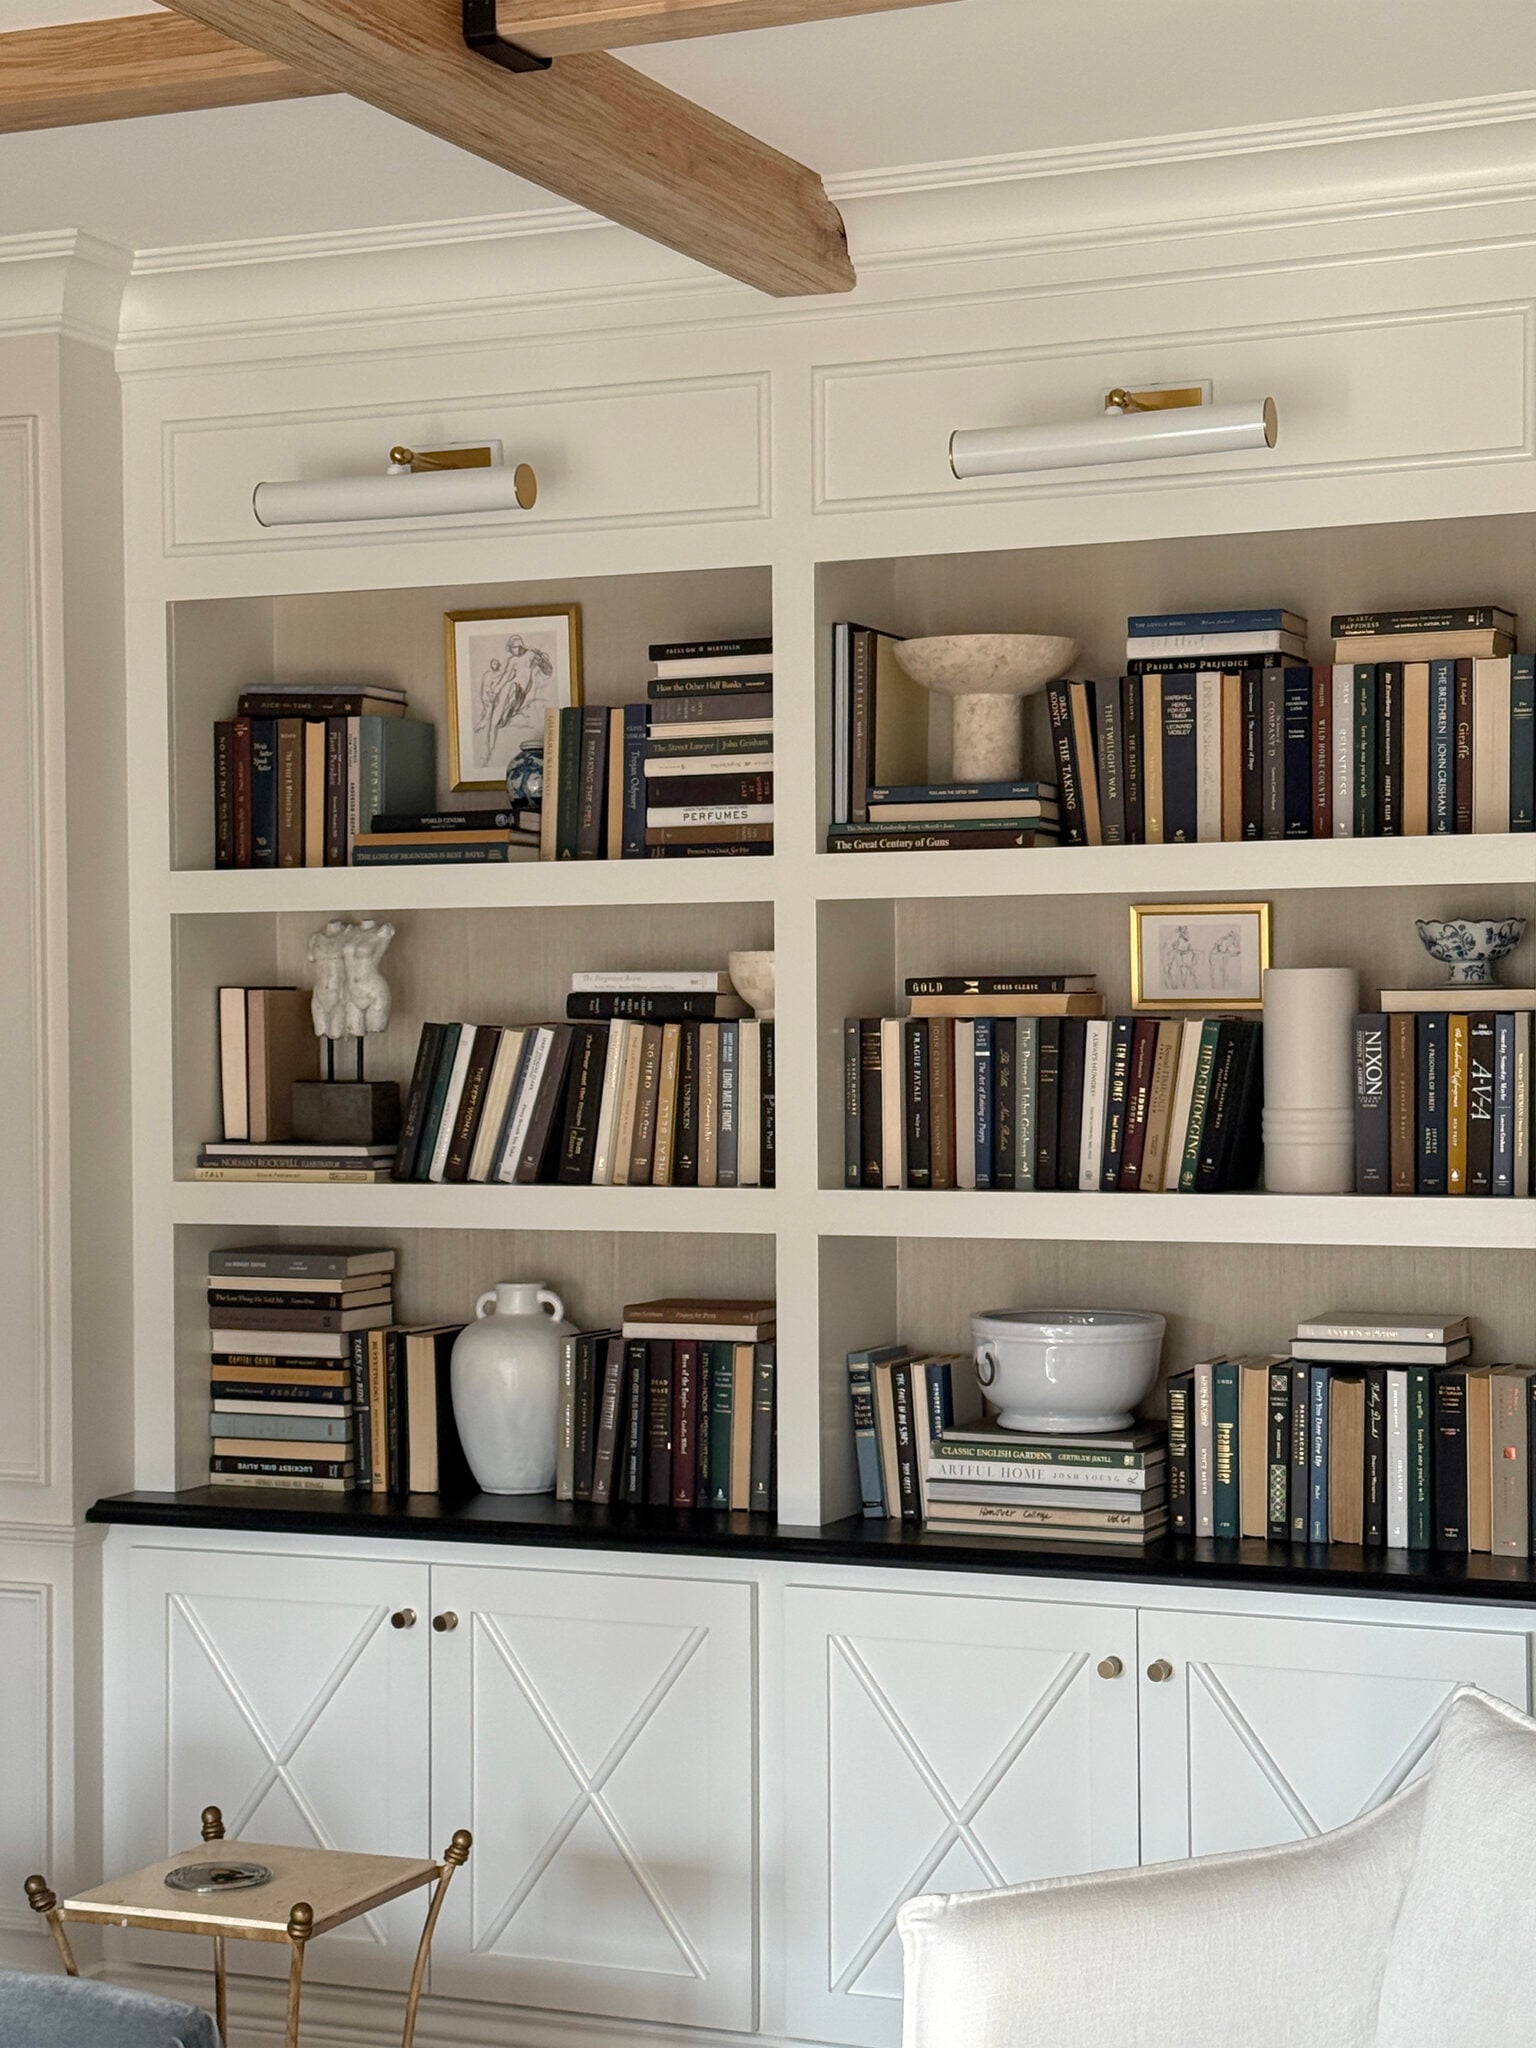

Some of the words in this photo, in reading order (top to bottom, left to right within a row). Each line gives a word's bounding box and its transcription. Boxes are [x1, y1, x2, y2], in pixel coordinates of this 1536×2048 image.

[1340, 622, 1379, 630] HAPPINESS
[1146, 662, 1173, 671] PRIDE
[1200, 660, 1248, 669] PREJUDICE
[1438, 666, 1447, 685] THE
[656, 684, 672, 692] How
[674, 683, 683, 691] the
[685, 682, 704, 690] Other
[706, 681, 720, 690] Half
[722, 680, 741, 688] Banks
[1050, 692, 1060, 727] KOONTZ
[1058, 696, 1068, 719] DEAN
[1104, 704, 1113, 723] THE
[1438, 686, 1447, 733] BRETHREN
[1318, 719, 1326, 740] WILD
[653, 744, 666, 752] The
[668, 742, 688, 751] Street
[690, 742, 713, 751] Lawyer
[722, 740, 737, 750] John
[739, 738, 768, 748] Grisham
[1059, 737, 1070, 762] THE
[1106, 726, 1116, 773] TWILIGHT
[1128, 734, 1136, 752] THE
[1458, 722, 1469, 759] Giraffe
[586, 740, 596, 782] BREAKING
[630, 750, 640, 776] Trojan
[1338, 729, 1346, 795] RELENTLESS
[1437, 743, 1446, 769] JOHN
[585, 786, 593, 802] THE
[628, 778, 640, 810] Odyssey
[1062, 764, 1076, 811] TAKING
[1109, 778, 1117, 799] WAR
[1437, 770, 1446, 816] GRISHAM
[584, 804, 592, 828] SPELL
[683, 811, 748, 821] PERFUMES
[835, 840, 852, 849] The
[853, 839, 878, 849] Great
[879, 839, 913, 850] Century
[914, 838, 925, 847] of
[926, 838, 949, 846] Guns
[913, 982, 943, 992] GOLD
[585, 1034, 593, 1049] The
[1022, 1028, 1031, 1047] The
[647, 1043, 654, 1058] NO
[913, 1032, 921, 1068] PRAGUE
[1116, 1043, 1127, 1058] TEN
[583, 1050, 591, 1070] Bear
[1021, 1050, 1030, 1085] Partner
[1364, 1030, 1383, 1096] NIXON
[475, 1067, 484, 1082] THE
[580, 1071, 588, 1086] and
[644, 1062, 654, 1089] HERO
[722, 1069, 734, 1088] LONG
[978, 1074, 986, 1085] Art
[1114, 1063, 1125, 1077] BIG
[470, 1085, 480, 1104] KEPT
[1112, 1080, 1124, 1102] ONES
[1428, 1082, 1435, 1091] OF
[1470, 1058, 1492, 1120] A-V-A
[683, 1084, 691, 1130] UNBROKEN
[722, 1090, 733, 1108] MILE
[977, 1094, 986, 1116] Raising
[1021, 1094, 1030, 1115] John
[1137, 1087, 1145, 1123] HIDDEN
[1186, 1044, 1214, 1159] HEDGEHOGGING
[460, 1106, 474, 1139] WOMAN
[576, 1102, 585, 1126] Dragon
[721, 1109, 732, 1132] HOME
[977, 1123, 986, 1144] Puppy
[1020, 1118, 1030, 1157] Grisham
[567, 1130, 576, 1159] Clancy
[575, 1137, 584, 1154] Tom
[222, 1159, 256, 1167] NORMAN
[301, 1160, 340, 1168] ILLUSTRATOR
[355, 1338, 363, 1363] TAKEN
[355, 1365, 363, 1376] for
[609, 1364, 618, 1377] THE
[681, 1354, 689, 1368] Hero
[607, 1379, 616, 1394] LAST
[896, 1373, 904, 1385] THE
[356, 1382, 364, 1404] RIDE
[679, 1388, 689, 1409] Empire
[897, 1388, 906, 1404] FAULT
[932, 1382, 940, 1414] HONORED
[1314, 1381, 1323, 1401] Don't
[604, 1396, 615, 1430] DETECTIVE
[898, 1414, 907, 1425] OUR
[1314, 1417, 1322, 1435] Dare
[899, 1426, 908, 1446] STARS
[1314, 1436, 1322, 1454] Give
[941, 1447, 975, 1456] CLASSIC
[977, 1448, 1012, 1458] ENGLISH
[1013, 1450, 1052, 1460] GARDENS
[1058, 1454, 1091, 1462] GERTRUDE
[1092, 1455, 1112, 1463] JEKYLL
[1216, 1422, 1234, 1484] Dreamhunter
[1313, 1455, 1321, 1467] Up
[279, 1465, 313, 1473] LUCKIEST
[902, 1462, 910, 1475] JOHN
[938, 1464, 994, 1478] ARTFUL
[1001, 1467, 1044, 1480] HOME
[1052, 1472, 1079, 1480] JOSH
[1084, 1474, 1121, 1482] YOUNG
[903, 1476, 911, 1494] GREEN
